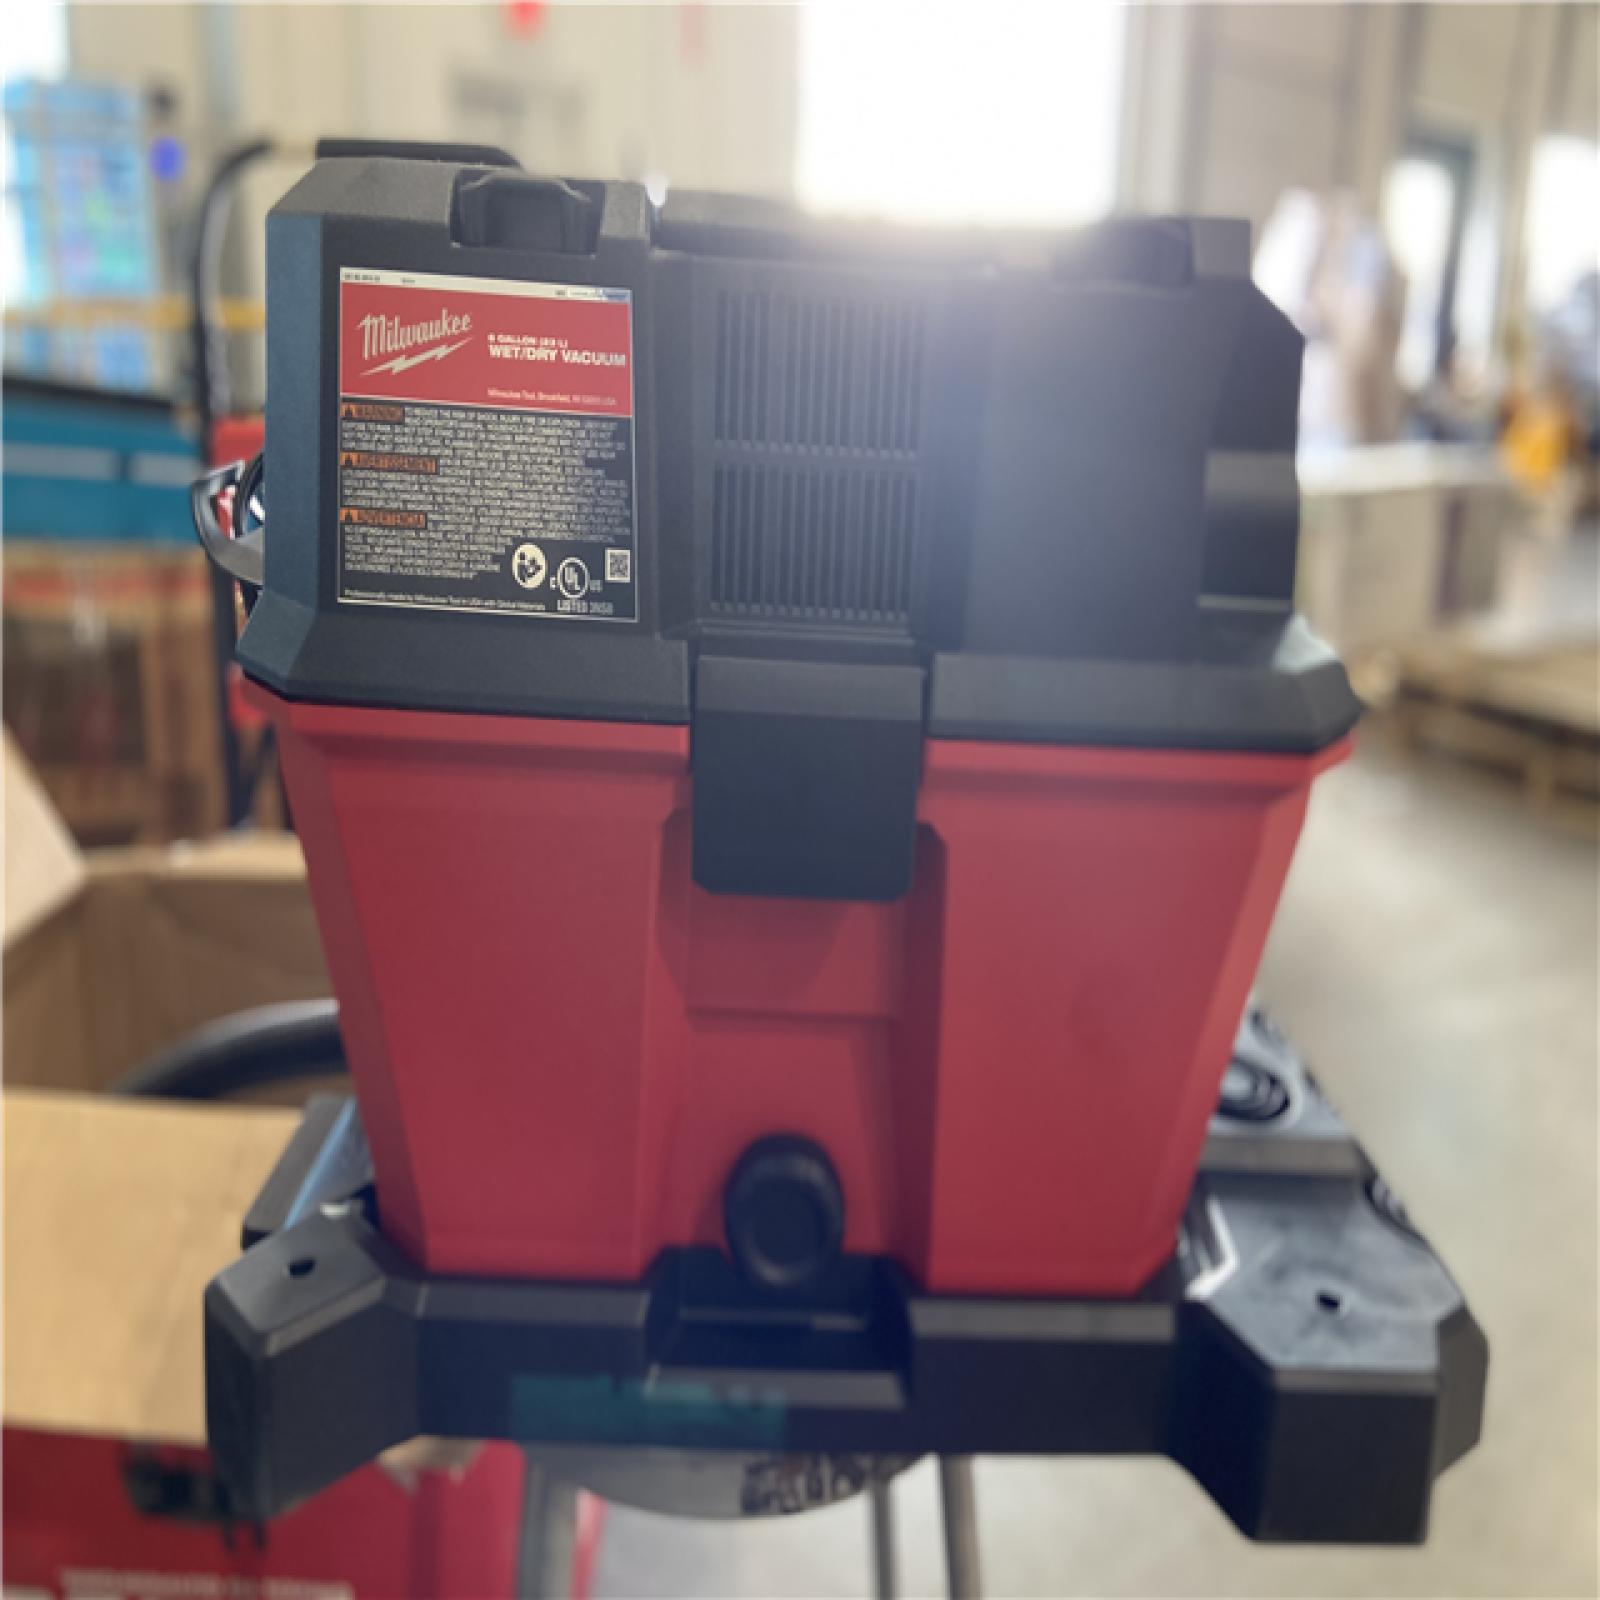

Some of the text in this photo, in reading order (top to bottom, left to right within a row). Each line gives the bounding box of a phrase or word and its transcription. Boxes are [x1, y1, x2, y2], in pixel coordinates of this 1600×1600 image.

[357, 308, 472, 360] Milwaukee
[497, 334, 536, 345] GALLON
[489, 345, 626, 367] WET/DRY VACUUM
